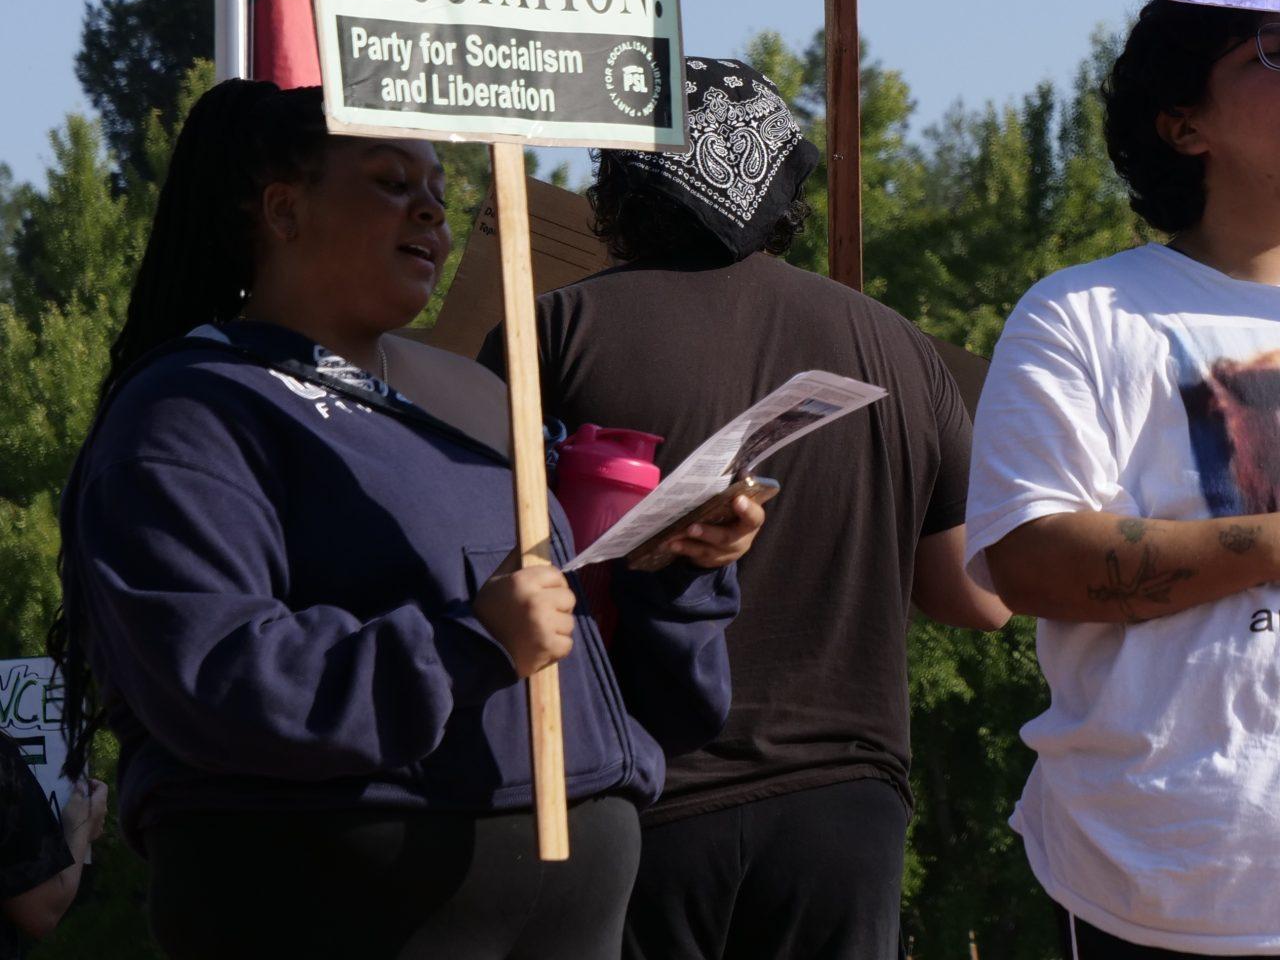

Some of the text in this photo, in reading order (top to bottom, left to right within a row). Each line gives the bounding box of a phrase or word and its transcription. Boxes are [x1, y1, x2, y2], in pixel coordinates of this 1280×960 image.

[351, 27, 583, 74] Party for Socialism
[381, 73, 556, 112] and Liberation
